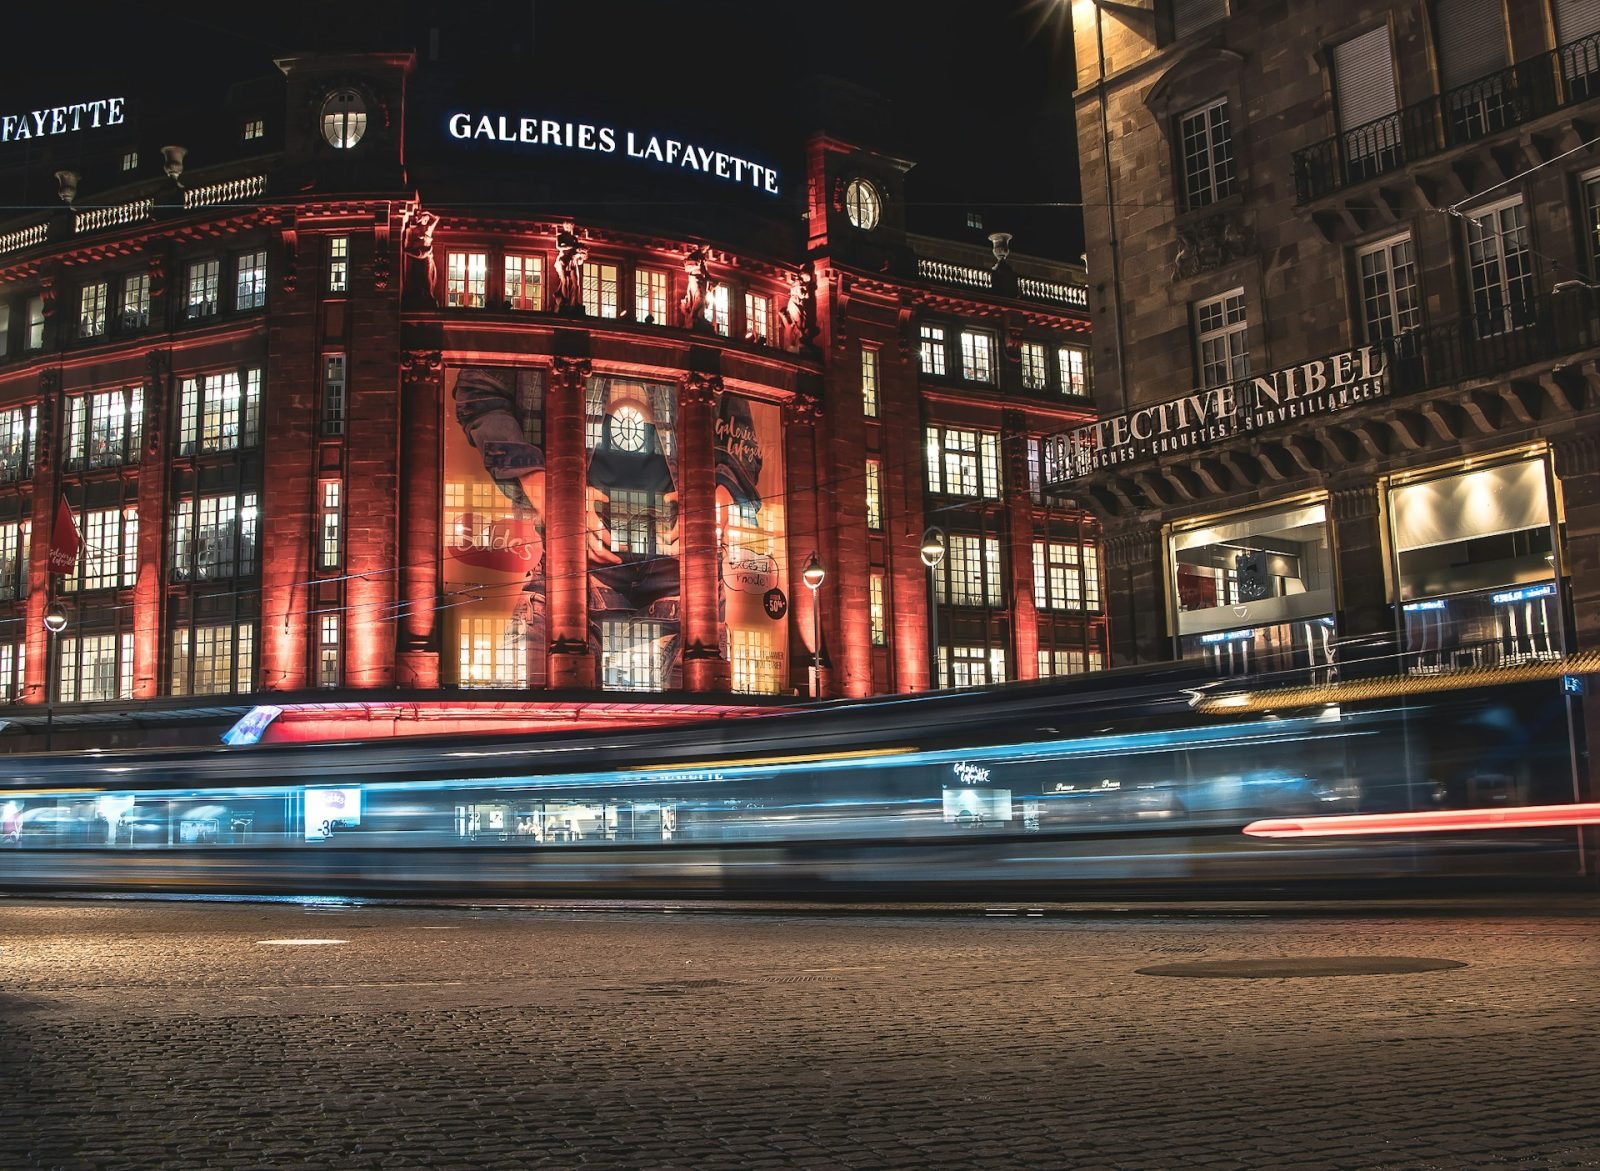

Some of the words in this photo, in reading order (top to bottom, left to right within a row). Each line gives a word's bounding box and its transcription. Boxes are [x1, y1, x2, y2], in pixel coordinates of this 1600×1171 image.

[2, 97, 125, 142] FAYETTE
[449, 113, 616, 153] GALERIES
[627, 131, 779, 194] LAFAYETTE
[1047, 385, 1239, 463] DETECTIVE
[1251, 345, 1388, 410] NIBEL
[1051, 447, 1136, 479] HERCHES
[1152, 423, 1227, 455] ENQUETES
[1245, 380, 1382, 431] SURVEILLANCES
[727, 437, 775, 463] Lafayet
[456, 525, 535, 561] Soldes
